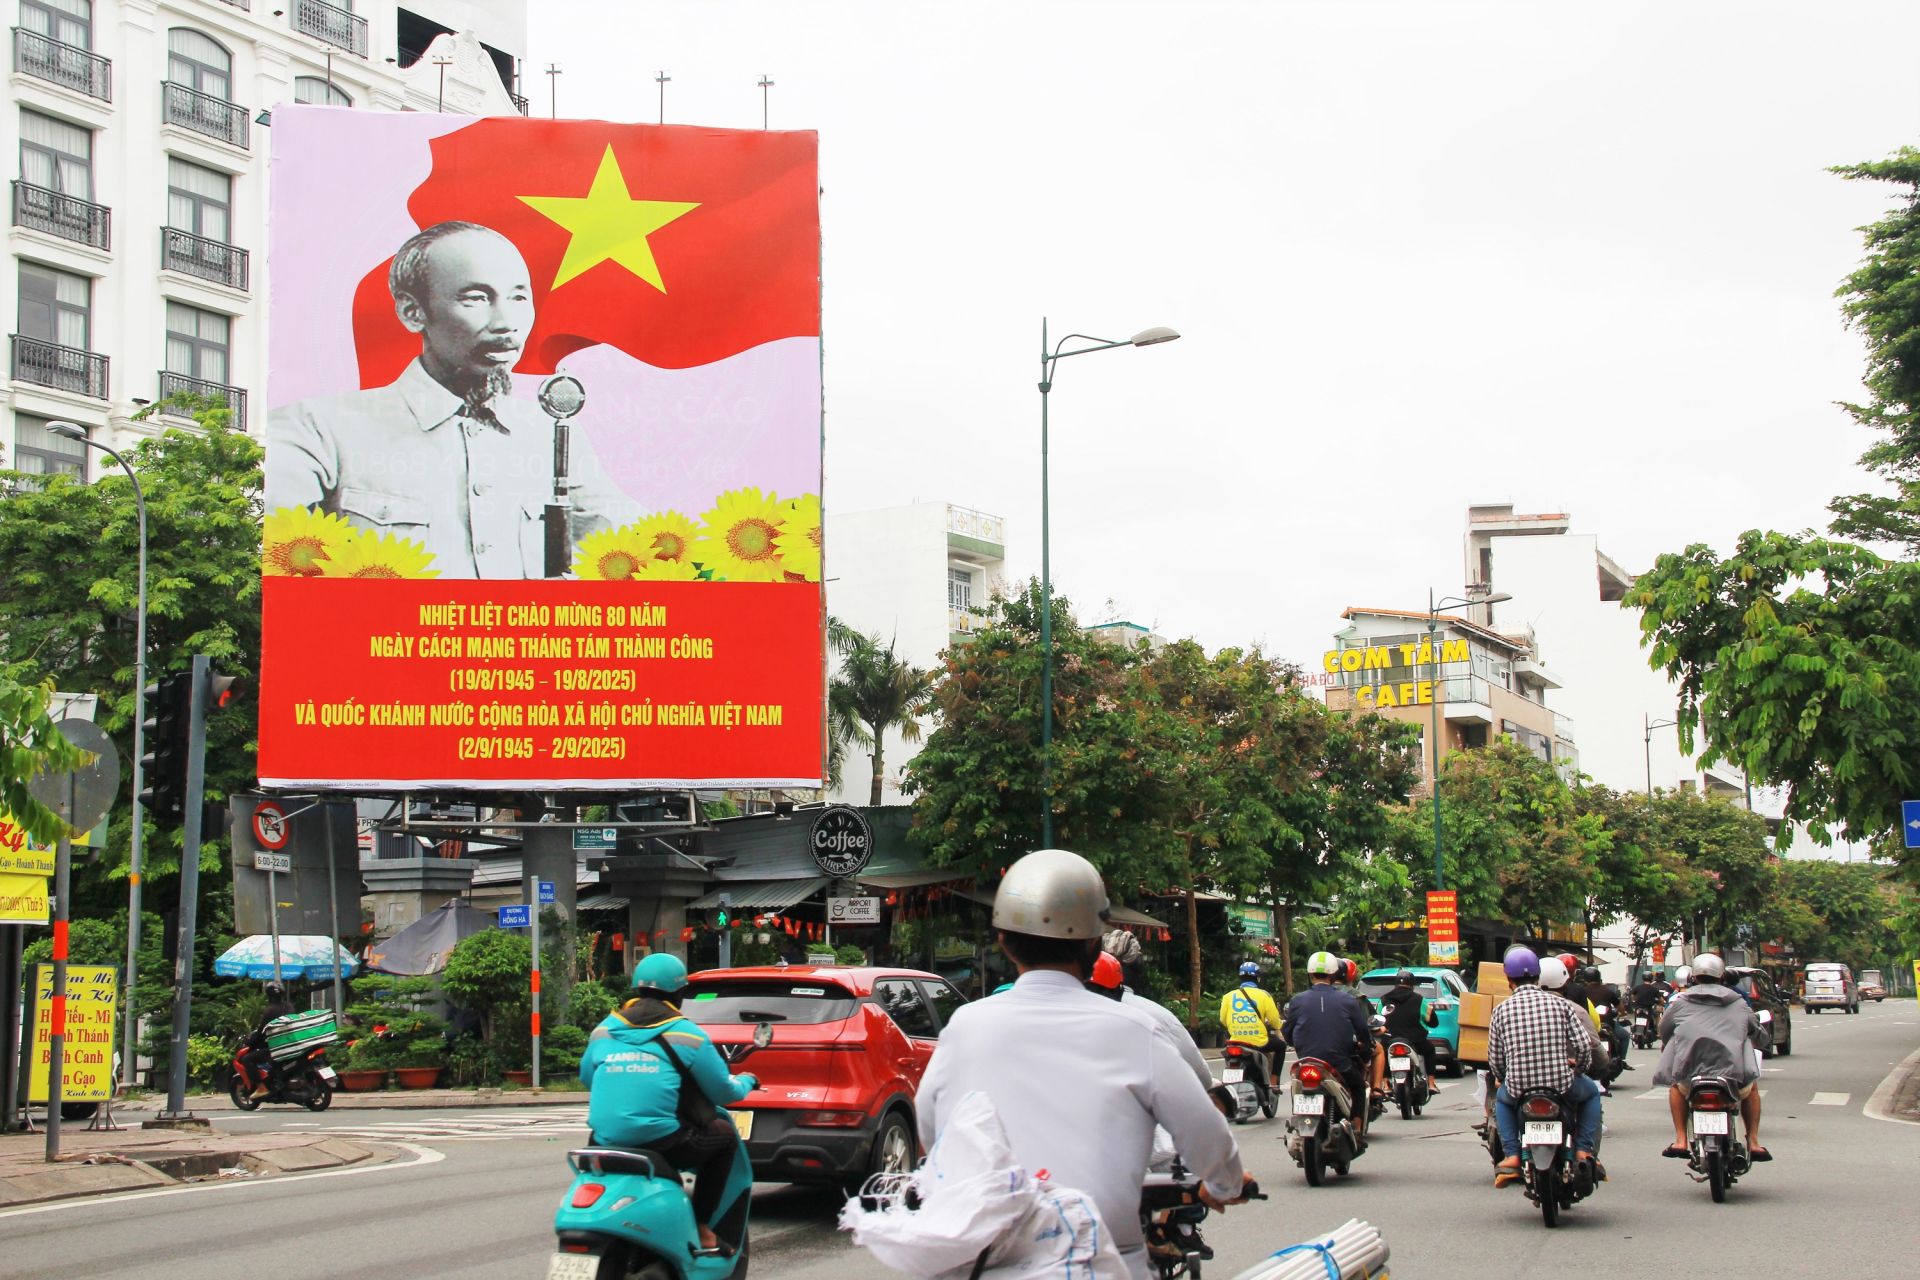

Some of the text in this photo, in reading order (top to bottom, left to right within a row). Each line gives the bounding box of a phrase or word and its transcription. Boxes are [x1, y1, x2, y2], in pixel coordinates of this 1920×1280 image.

[419, 601, 667, 630] NHIỆT LIỆT CHÀO MỪNG 80 NĂM
[370, 633, 713, 663] NGÀY CÁCH MẠNG THÁNG TÁM THÀNH CÔNG
[450, 669, 535, 692] (19/8/1945
[554, 669, 637, 692] 19/8/2025)
[295, 698, 783, 731] VÀ QUỐC KHÁNH NƯỚC CỘNG HÒA XÃ HỘI CHỦ NGHĨA VIỆT NAM
[458, 736, 534, 760] (2/9/1945
[552, 736, 627, 760] 2/9/2025)
[815, 830, 865, 851] Coffee
[820, 854, 860, 871] AIRPORT
[848, 899, 871, 907] AIRPORT
[850, 907, 870, 915] COFFEE
[96, 1009, 111, 1024] Mì
[76, 1028, 109, 1043] Thánh
[74, 1049, 104, 1064] Canh
[73, 1070, 96, 1088] Gạo
